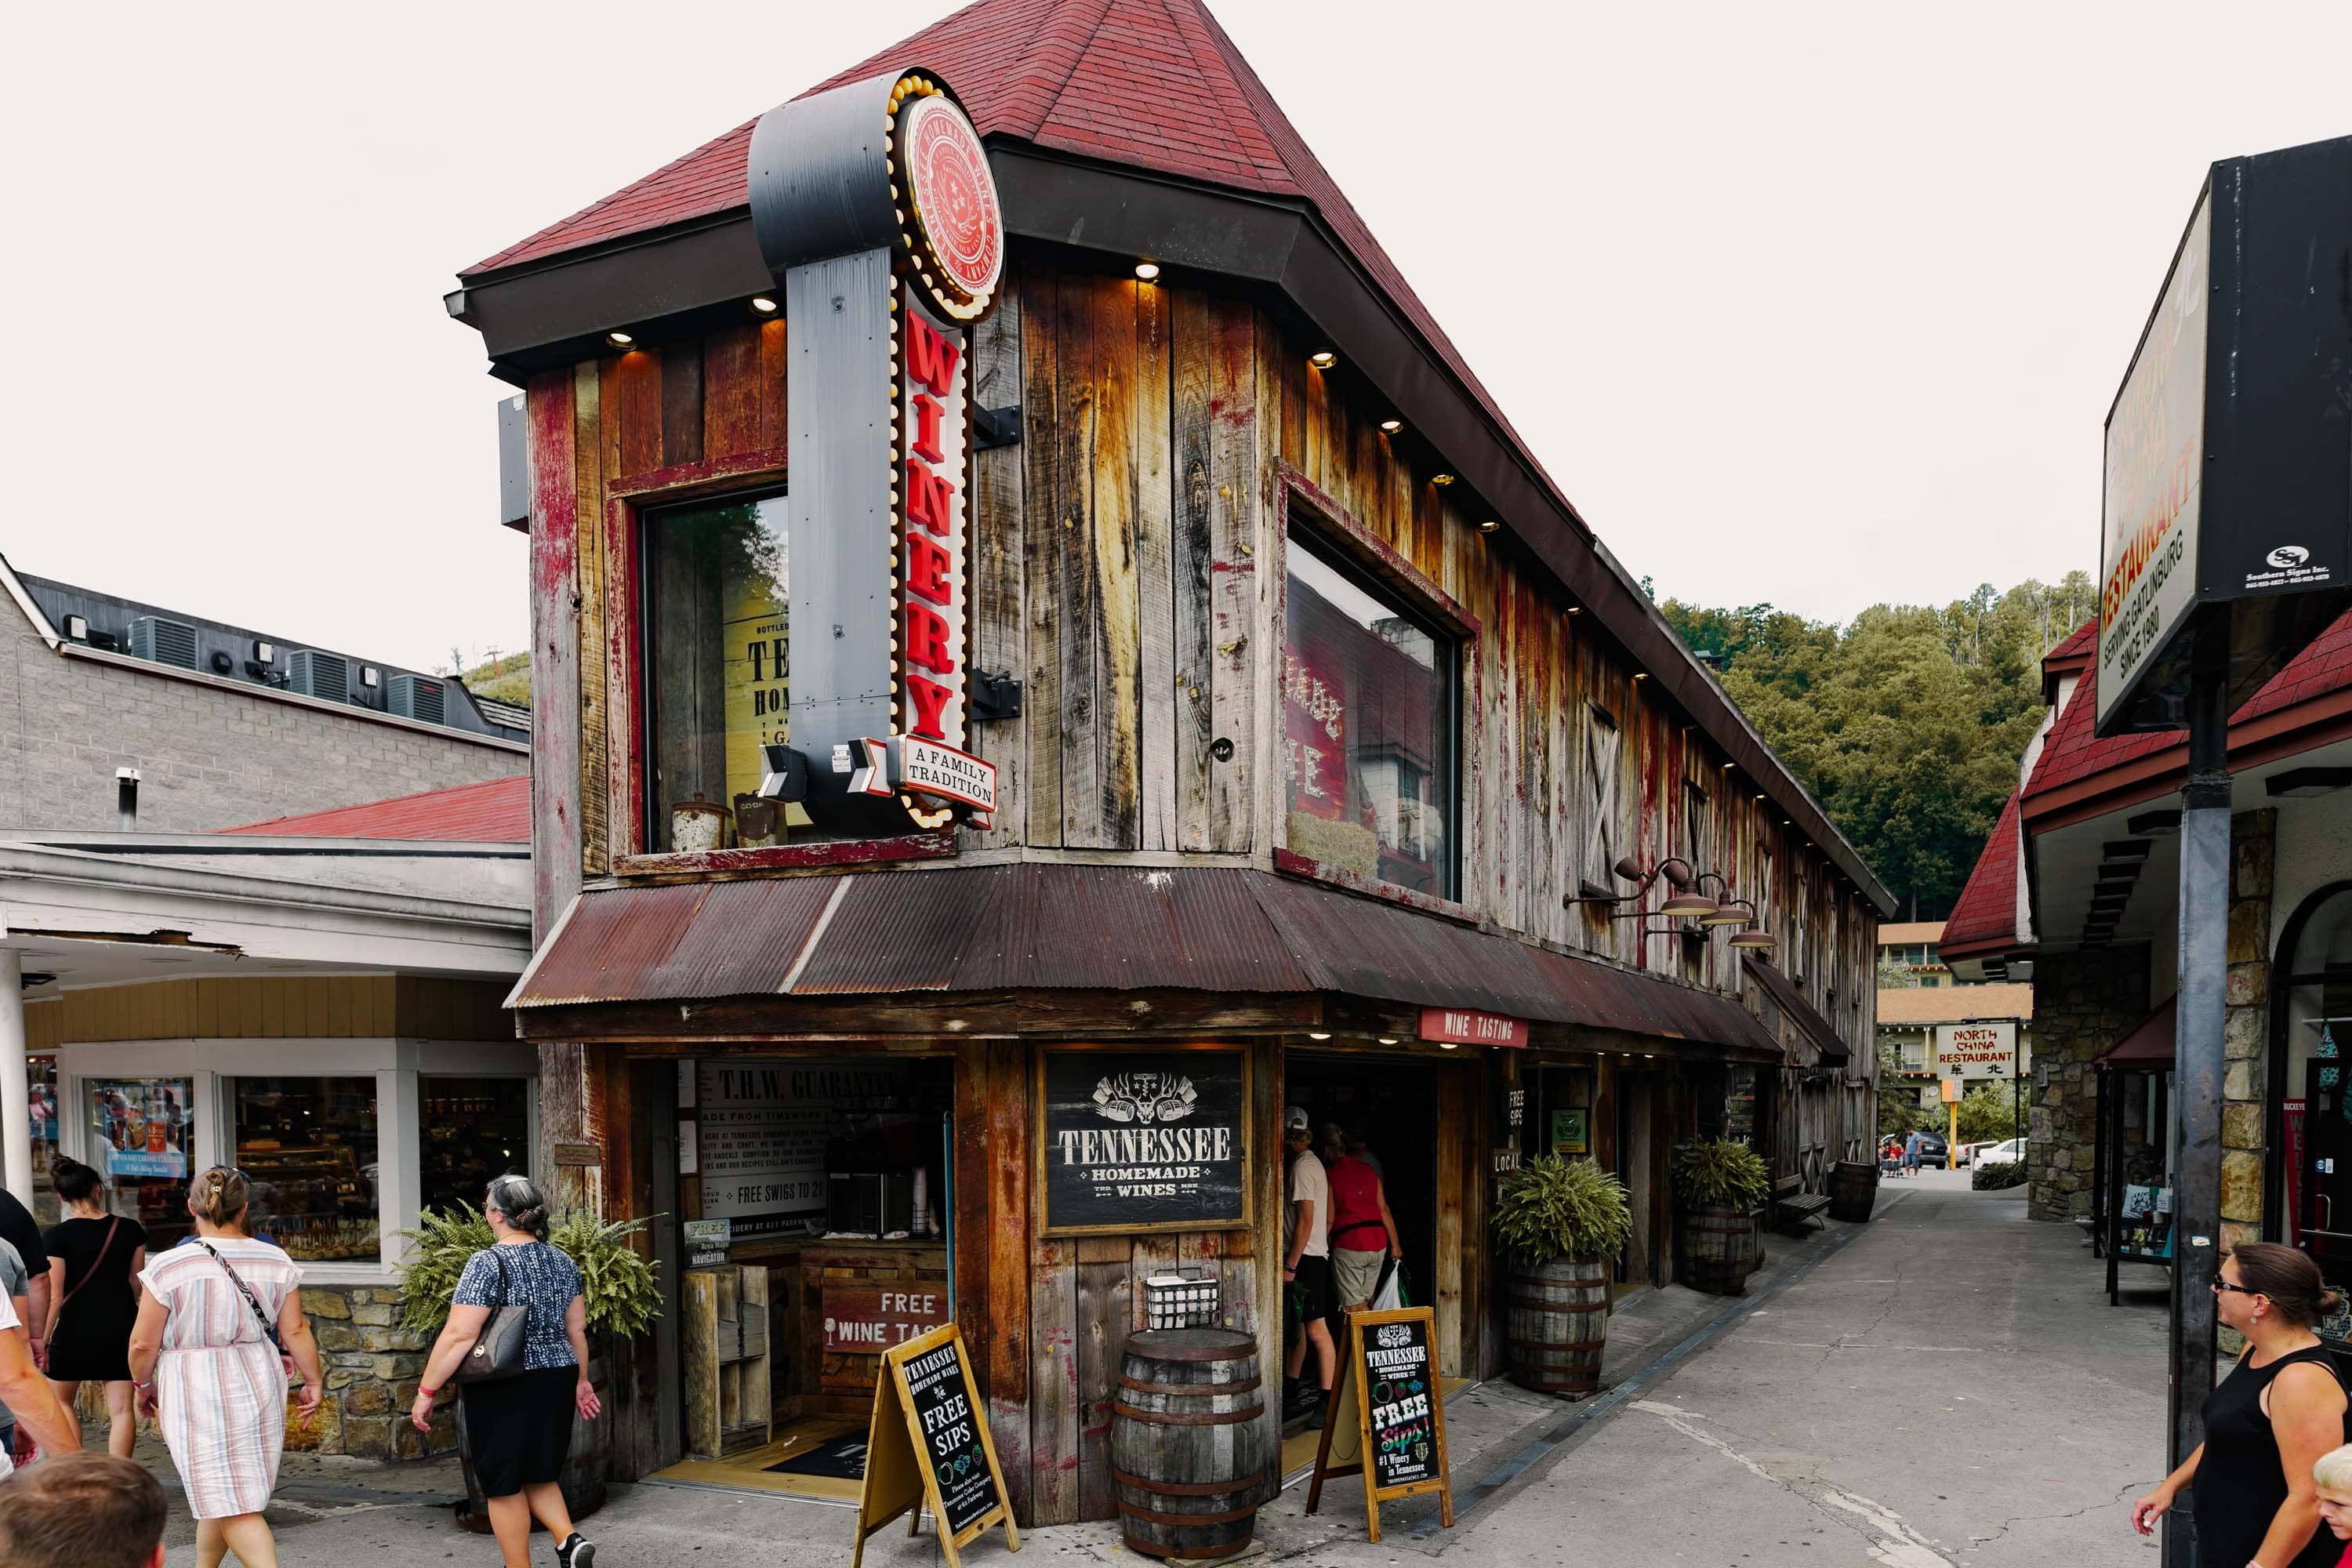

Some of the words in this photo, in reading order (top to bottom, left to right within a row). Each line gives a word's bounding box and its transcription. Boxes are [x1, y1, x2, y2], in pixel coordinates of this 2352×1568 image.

[924, 118, 971, 158] HOMEMADE
[919, 149, 951, 263] TENNESSEE
[974, 165, 994, 226] WINES
[966, 234, 994, 281] COMPANY
[906, 309, 960, 741] WINERY
[2101, 437, 2194, 641] RESTAURANT
[2245, 572, 2285, 582] Southern
[2286, 568, 2311, 577] Signs
[2104, 608, 2131, 670] SERVING
[2131, 529, 2183, 629] GATLINBURG
[757, 623, 789, 634] BOTTLED
[2120, 639, 2141, 680] SINCE
[2142, 605, 2159, 652] 1980
[916, 748, 925, 763] A
[929, 751, 988, 782] FAMILY
[909, 764, 993, 804] TRADITION
[1445, 1012, 1470, 1037] WINE
[1477, 1016, 1513, 1041] TASTING
[1954, 1030, 1998, 1040] NORTH
[1957, 1041, 1995, 1051] CHINA
[1939, 1052, 2013, 1064] RESTAURANT
[719, 1069, 785, 1099] T.H.W.
[1509, 1090, 1524, 1108] FREE
[2283, 1102, 2306, 1111] BUCKEYE
[702, 1113, 726, 1122] ADE
[731, 1112, 760, 1121] FROM
[1058, 1127, 1231, 1165] TENNESSEE
[1495, 1154, 1520, 1172] LOCAL
[1091, 1167, 1200, 1181] HOMEMADE
[739, 1185, 762, 1203] FREE
[765, 1184, 795, 1202] SWIGS
[798, 1182, 809, 1199] TO
[1116, 1184, 1176, 1197] WINES
[689, 1221, 725, 1236] FREE
[715, 1241, 730, 1250] Maps
[691, 1253, 725, 1265] NAVIGATOR
[881, 1293, 935, 1314] FREE
[839, 1322, 887, 1343] WINE
[904, 1345, 956, 1382] TENNESSEE
[1367, 1346, 1425, 1367] TENNESSEE
[1378, 1363, 1416, 1374] HOMEMADE
[910, 1372, 942, 1396] HOMEMADE
[942, 1364, 959, 1378] WINES
[923, 1393, 967, 1435] FREE
[1373, 1393, 1428, 1432] FREE
[935, 1421, 971, 1457] SIPS
[1379, 1454, 1388, 1466] #1
[1388, 1454, 1410, 1464] Winery
[1388, 1466, 1395, 1476] in
[1395, 1464, 1425, 1475] Tennessee
[952, 1483, 964, 1493] Please
[964, 1486, 975, 1495] Cider
[975, 1475, 991, 1489] Company
[967, 1490, 984, 1504] Parkway
